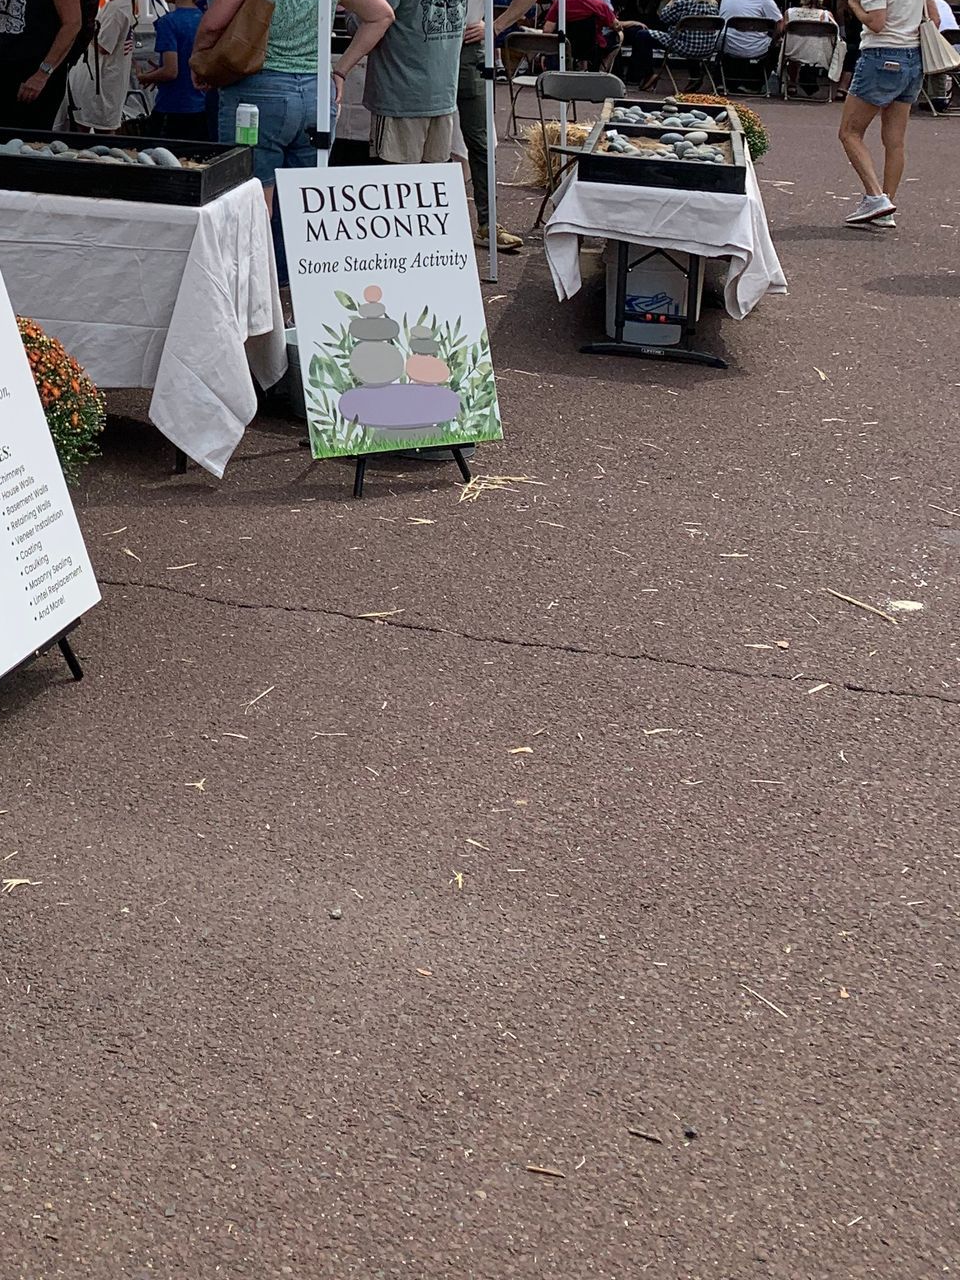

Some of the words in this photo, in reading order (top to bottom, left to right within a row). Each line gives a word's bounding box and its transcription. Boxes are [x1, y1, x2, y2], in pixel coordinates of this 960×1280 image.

[298, 181, 449, 214] DISCIPLE
[306, 213, 450, 243] MASONRY
[298, 258, 339, 275] Stone
[344, 252, 408, 274] Stacking
[410, 249, 468, 270] Activity
[1, 485, 20, 500] House
[19, 476, 34, 490] Walls
[6, 493, 34, 515] Basement
[33, 484, 48, 498] Walls
[10, 509, 37, 530] Retaining
[36, 500, 52, 514] Walls
[15, 528, 34, 544] Veneer
[34, 509, 64, 532] Installation
[20, 541, 43, 560] Coating
[24, 554, 49, 575] Caulking
[28, 569, 52, 590] Masonry
[52, 556, 72, 574] Sealing
[33, 588, 48, 606] Lintel
[48, 565, 82, 594] Replacement
[38, 607, 50, 620] And
[49, 595, 65, 611] More!
